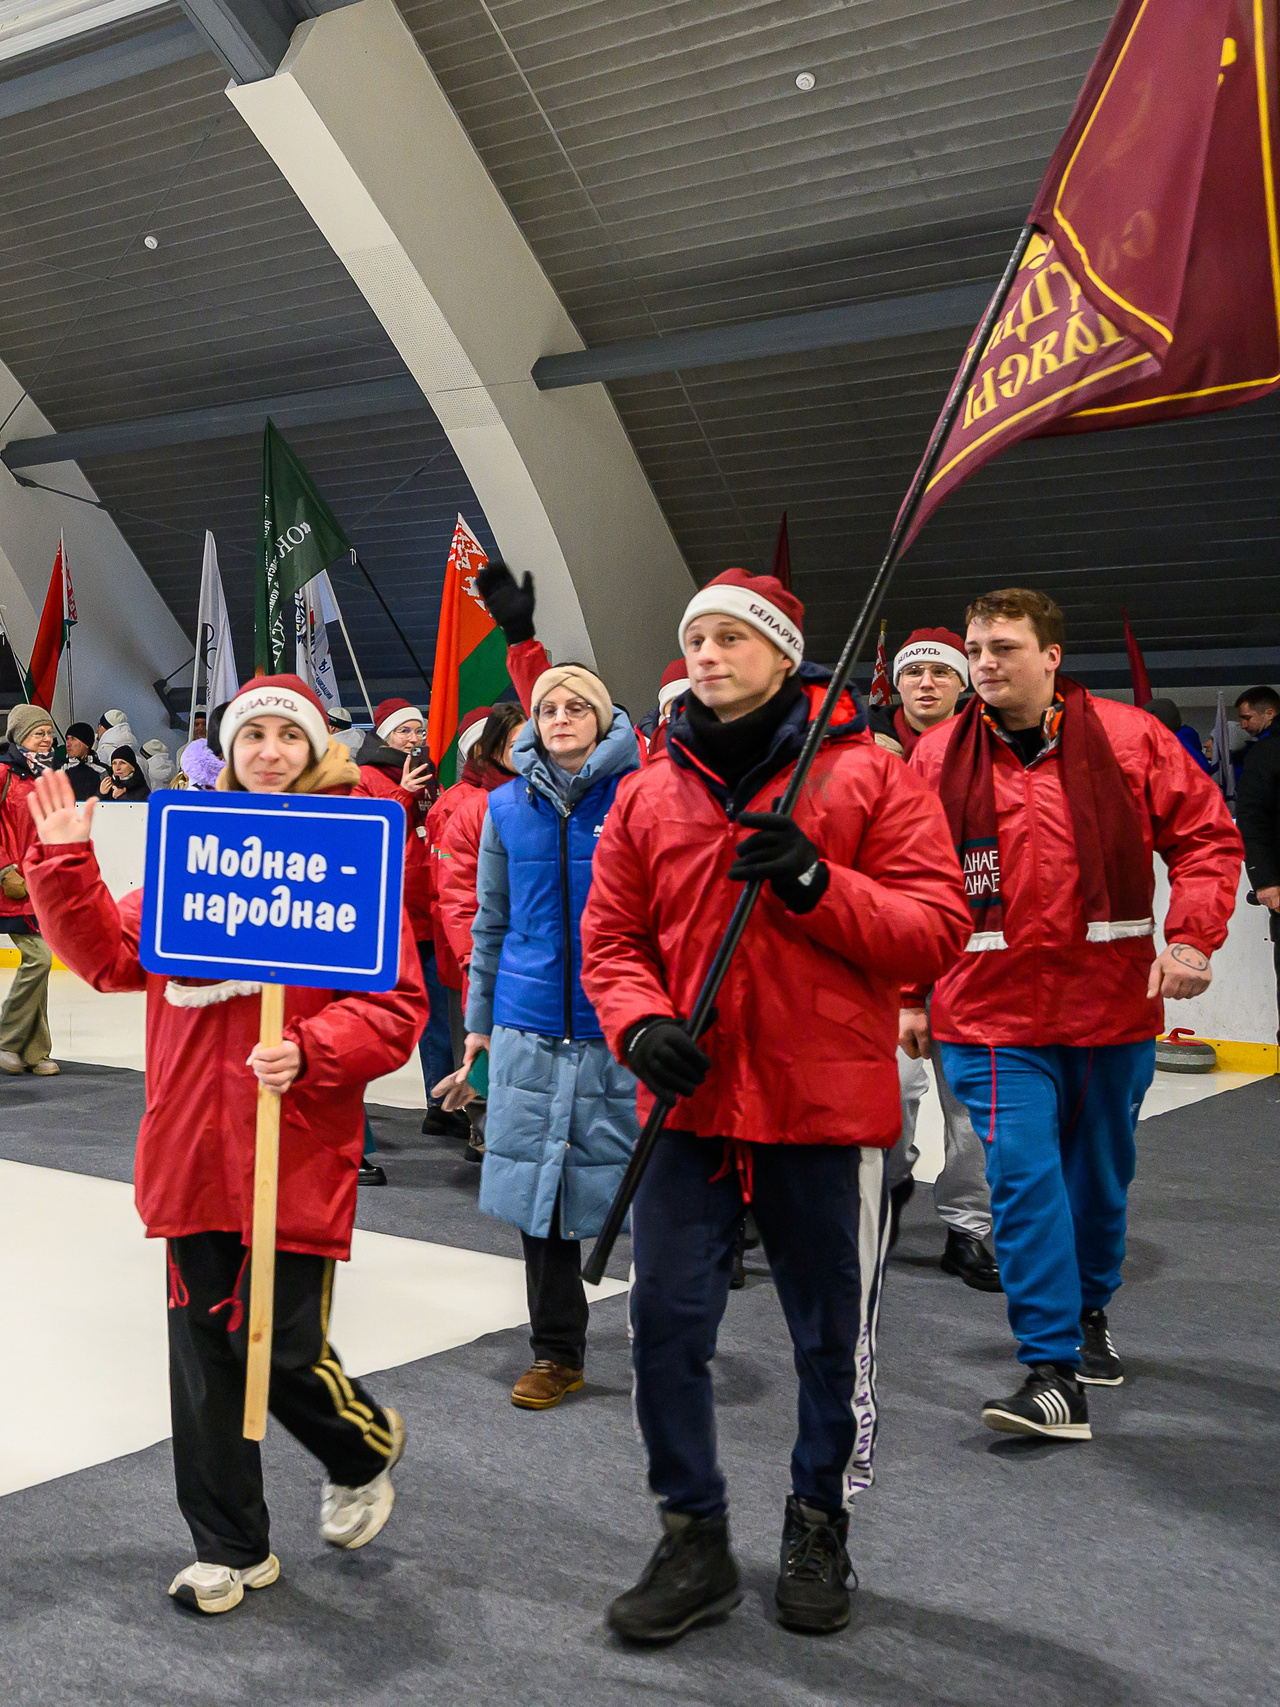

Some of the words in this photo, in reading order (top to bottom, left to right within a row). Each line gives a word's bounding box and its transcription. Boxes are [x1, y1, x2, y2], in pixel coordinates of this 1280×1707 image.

[749, 603, 802, 653] БЕЛАРУС
[186, 834, 327, 883] Моднае
[182, 885, 357, 937] народнае
